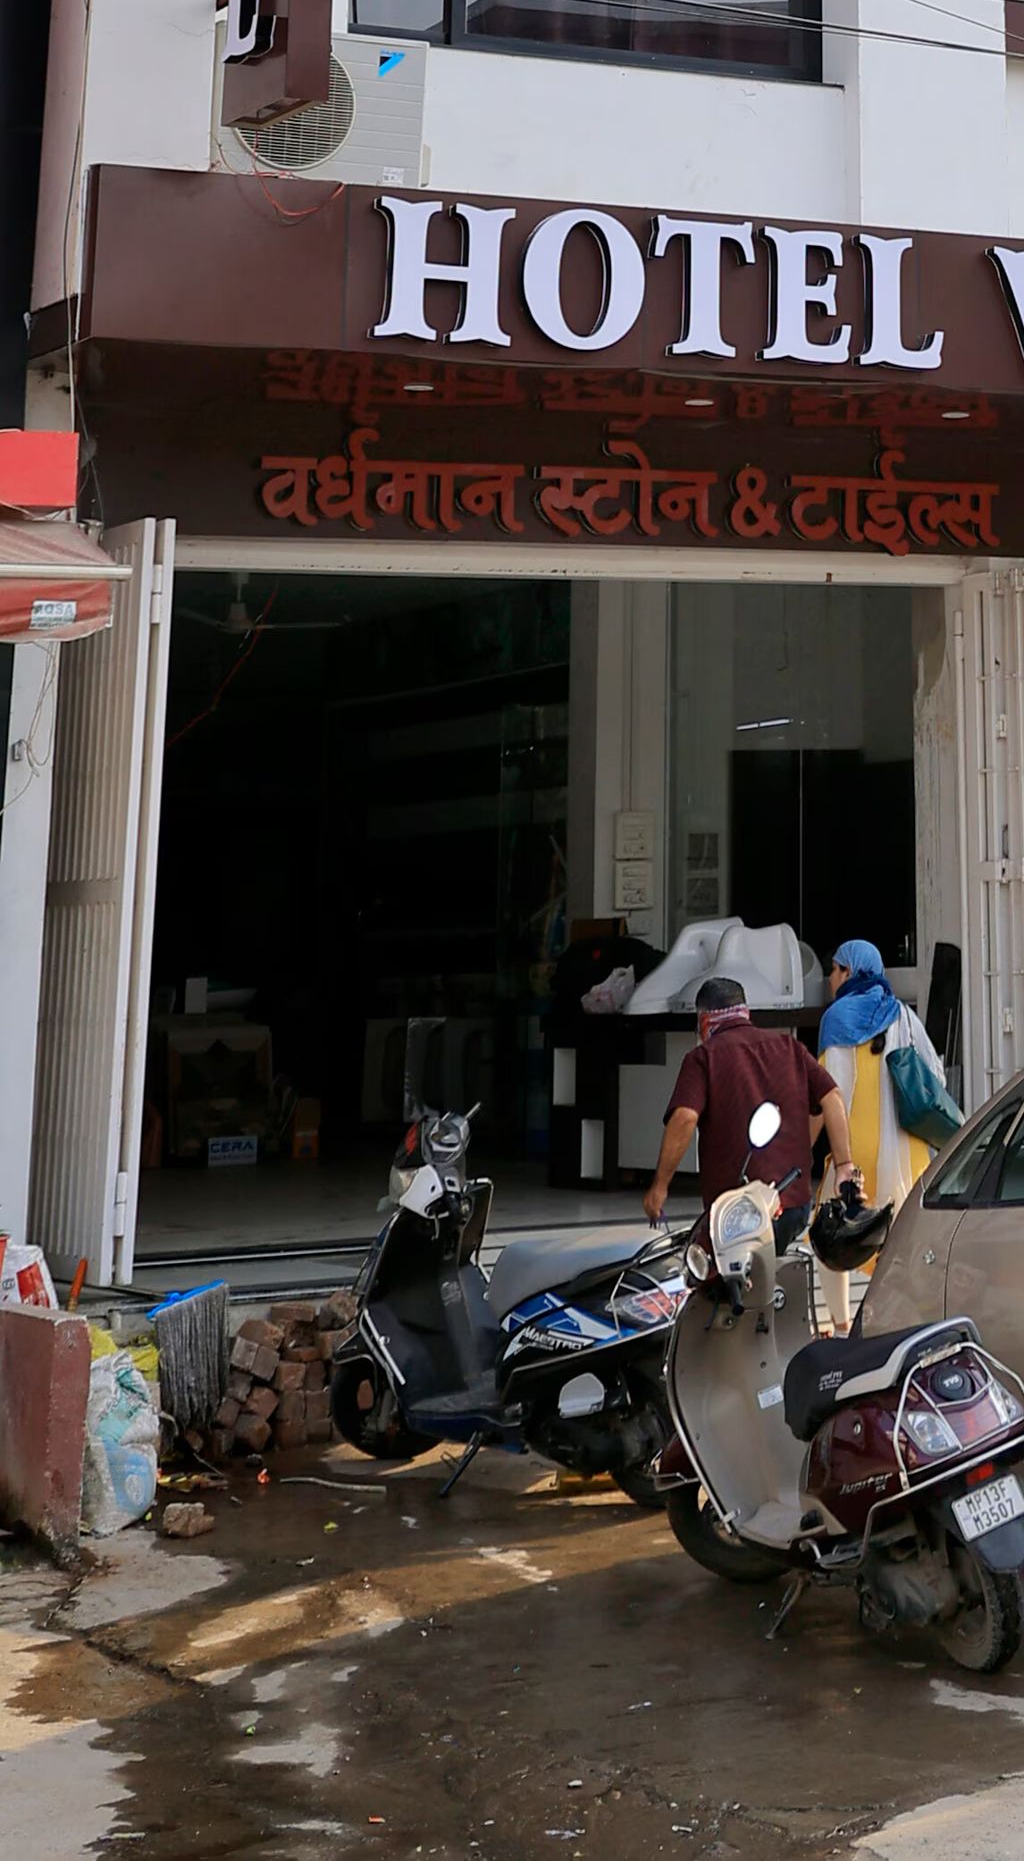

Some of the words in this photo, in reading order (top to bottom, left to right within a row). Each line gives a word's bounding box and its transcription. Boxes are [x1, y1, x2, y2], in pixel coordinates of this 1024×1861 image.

[369, 196, 944, 370] HOTEL
[258, 428, 525, 534] वर्धमान
[531, 436, 721, 539] स्टोन
[728, 463, 781, 539] &
[784, 449, 1002, 556] टाईल्स
[943, 1374, 960, 1388] TVS
[972, 1497, 1016, 1533] M3507
